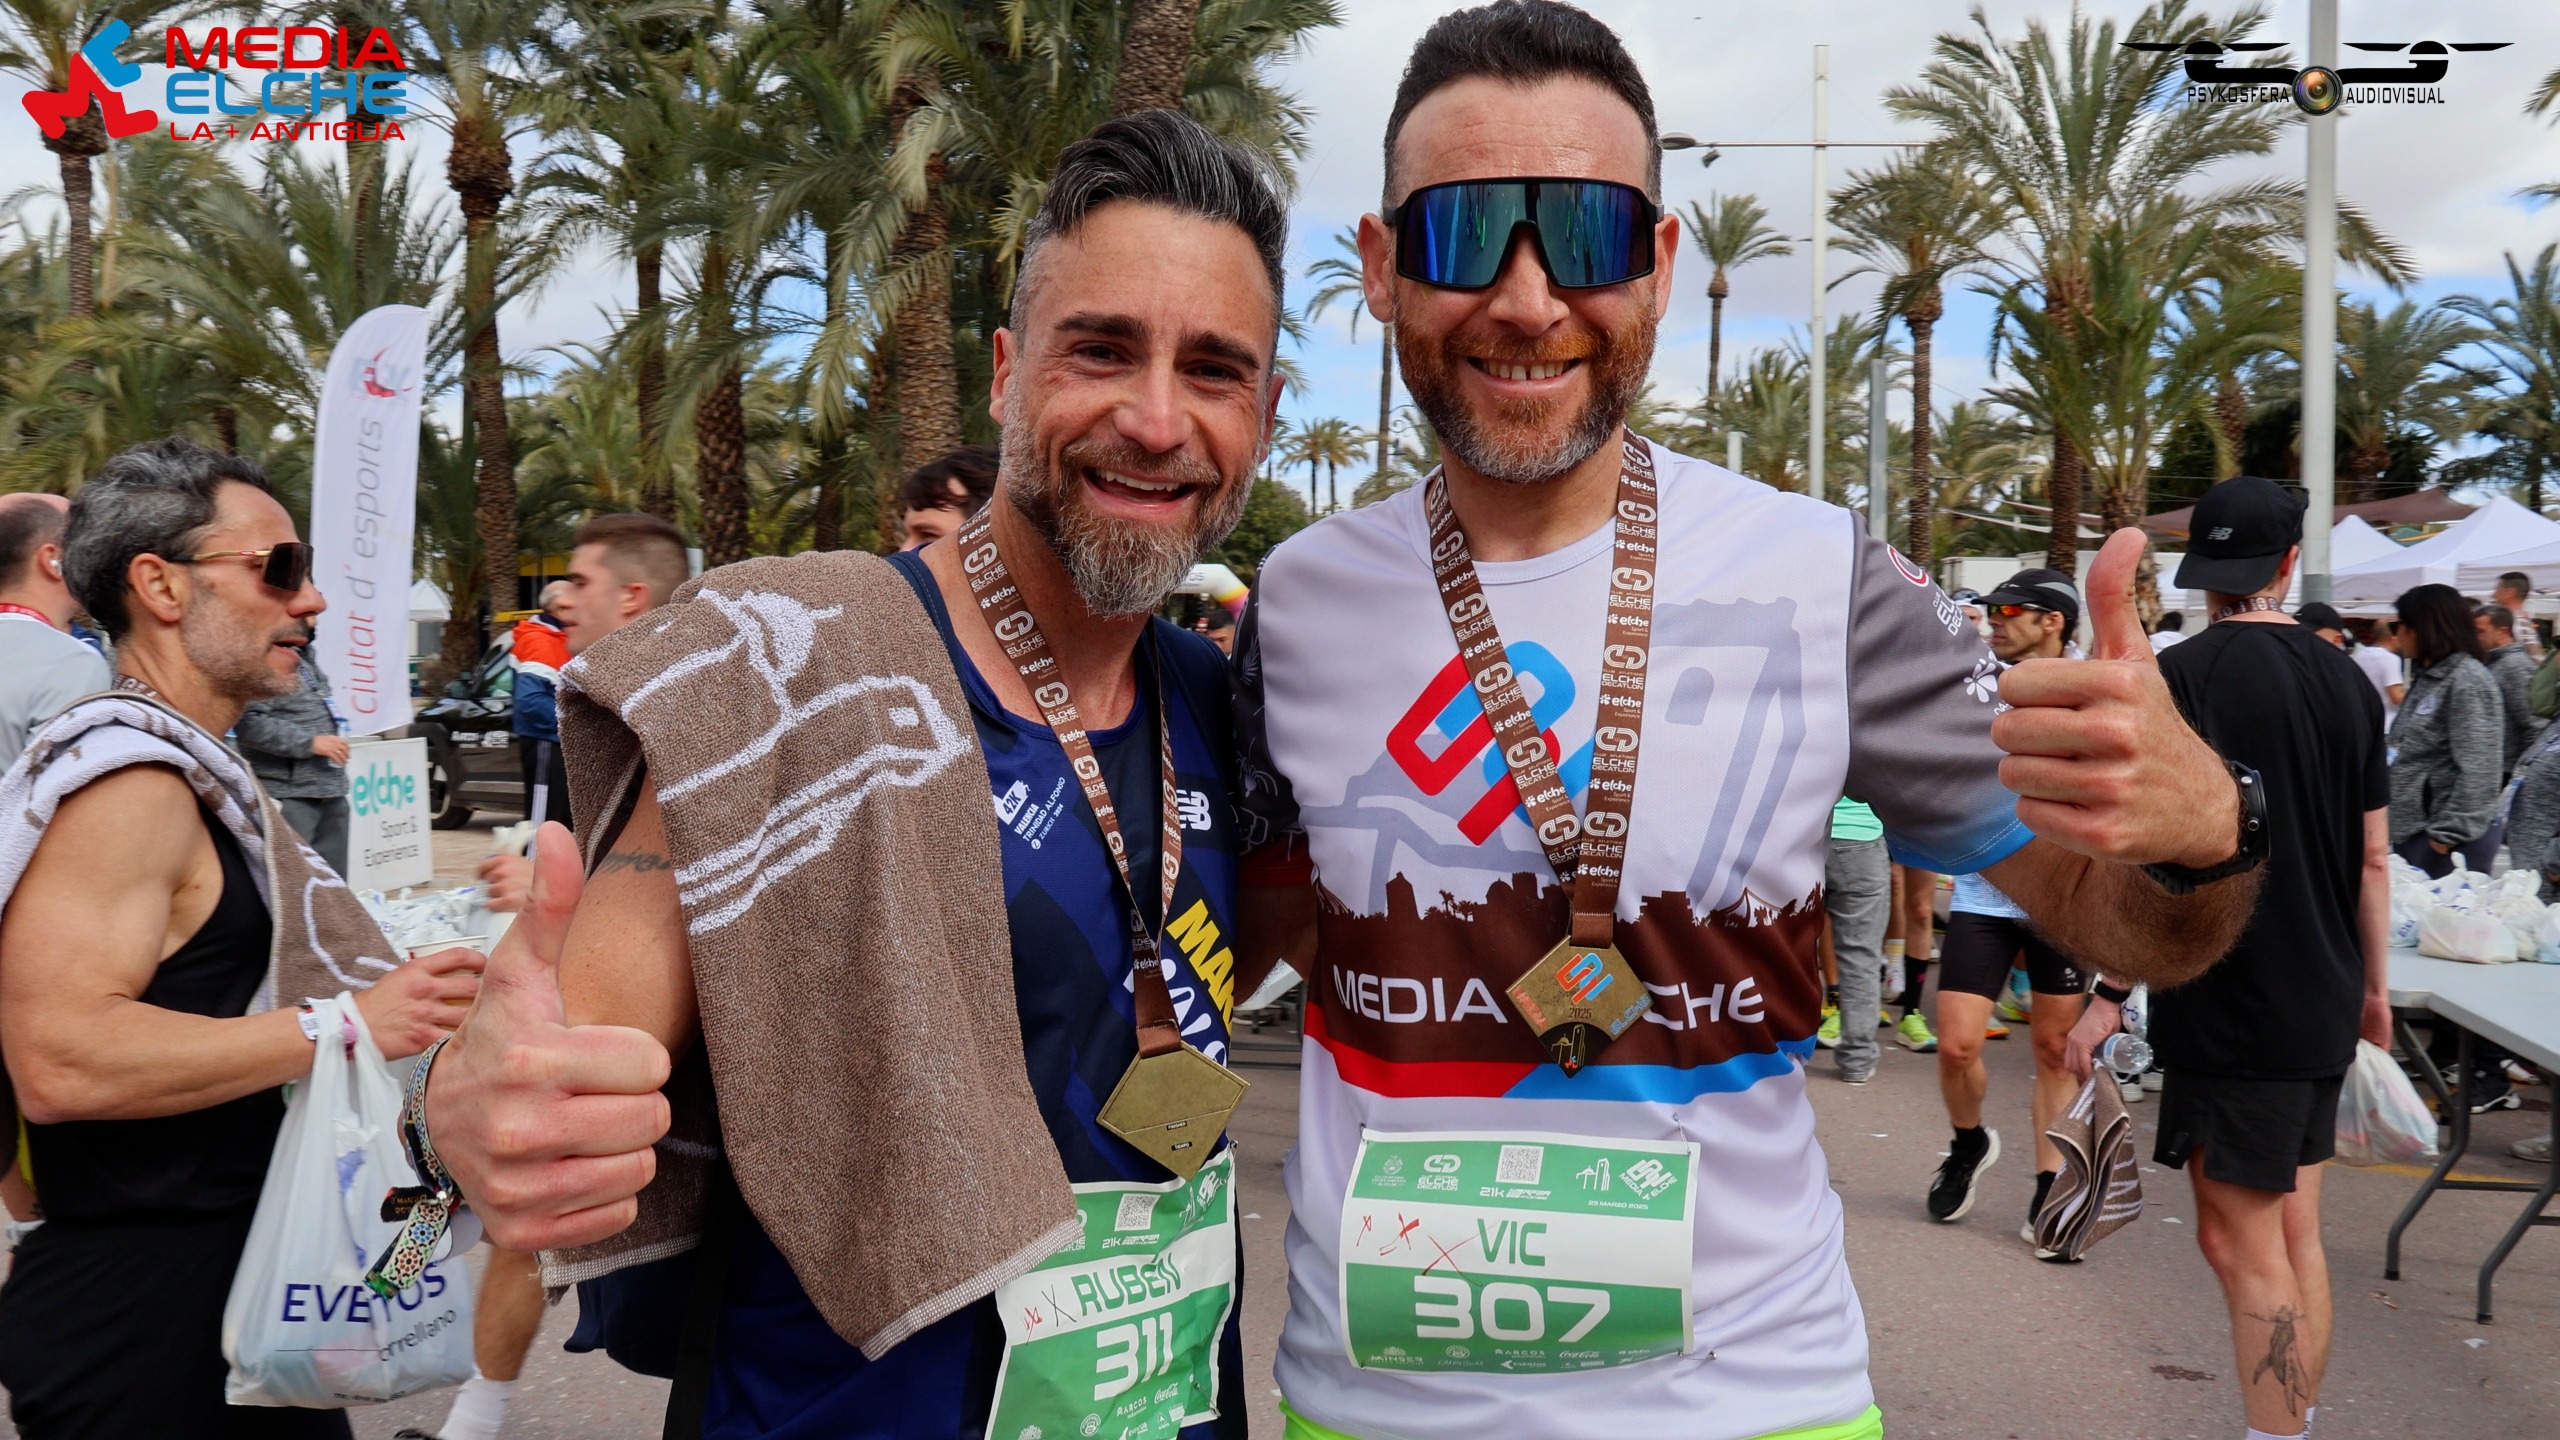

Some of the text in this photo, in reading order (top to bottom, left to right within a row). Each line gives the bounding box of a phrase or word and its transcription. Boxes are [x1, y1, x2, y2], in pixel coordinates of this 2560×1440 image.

[1609, 601, 1651, 611] DECATLON
[1610, 594, 1651, 606] ELCHE
[1619, 615, 1649, 627] elche
[343, 611, 378, 714] ciutat
[1601, 680, 1644, 690] DECATLON
[1602, 673, 1645, 686] ELCHE
[1484, 686, 1522, 709] ELCHE
[1611, 695, 1642, 708] elche
[1504, 710, 1532, 728] elche
[1591, 764, 1635, 773] DECATLON
[1592, 757, 1636, 769] ELCHE
[1516, 762, 1556, 784] ELCHE
[1518, 769, 1558, 789] DECATLON
[353, 760, 415, 817] elche
[1601, 779, 1632, 792] elche
[1003, 791, 1022, 814] 42K
[1536, 786, 1566, 803] elche
[1022, 776, 1066, 842] TRINIDAD ALFONSO
[1014, 803, 1039, 835] VALENCIA
[364, 844, 419, 868] Experience
[1548, 844, 1581, 861] ELCH
[1579, 850, 1623, 859] DECATLON
[1580, 842, 1624, 854] ELCHE
[1551, 854, 1579, 866] DECATL
[1589, 865, 1620, 877] elche
[1333, 964, 1764, 1031] MEDIA CHE
[1568, 1007, 1592, 1019] 2025
[1609, 994, 1650, 1035] ELCHE
[1418, 1176, 1460, 1186] ELCHE
[1619, 1172, 1678, 1197] MEDIA ELCHE
[1599, 1200, 1627, 1208] MARZO
[1477, 1218, 1547, 1267] VIC
[1414, 1274, 1611, 1343] 307
[378, 1309, 457, 1361] orrellano
[1093, 1311, 1174, 1401] 311
